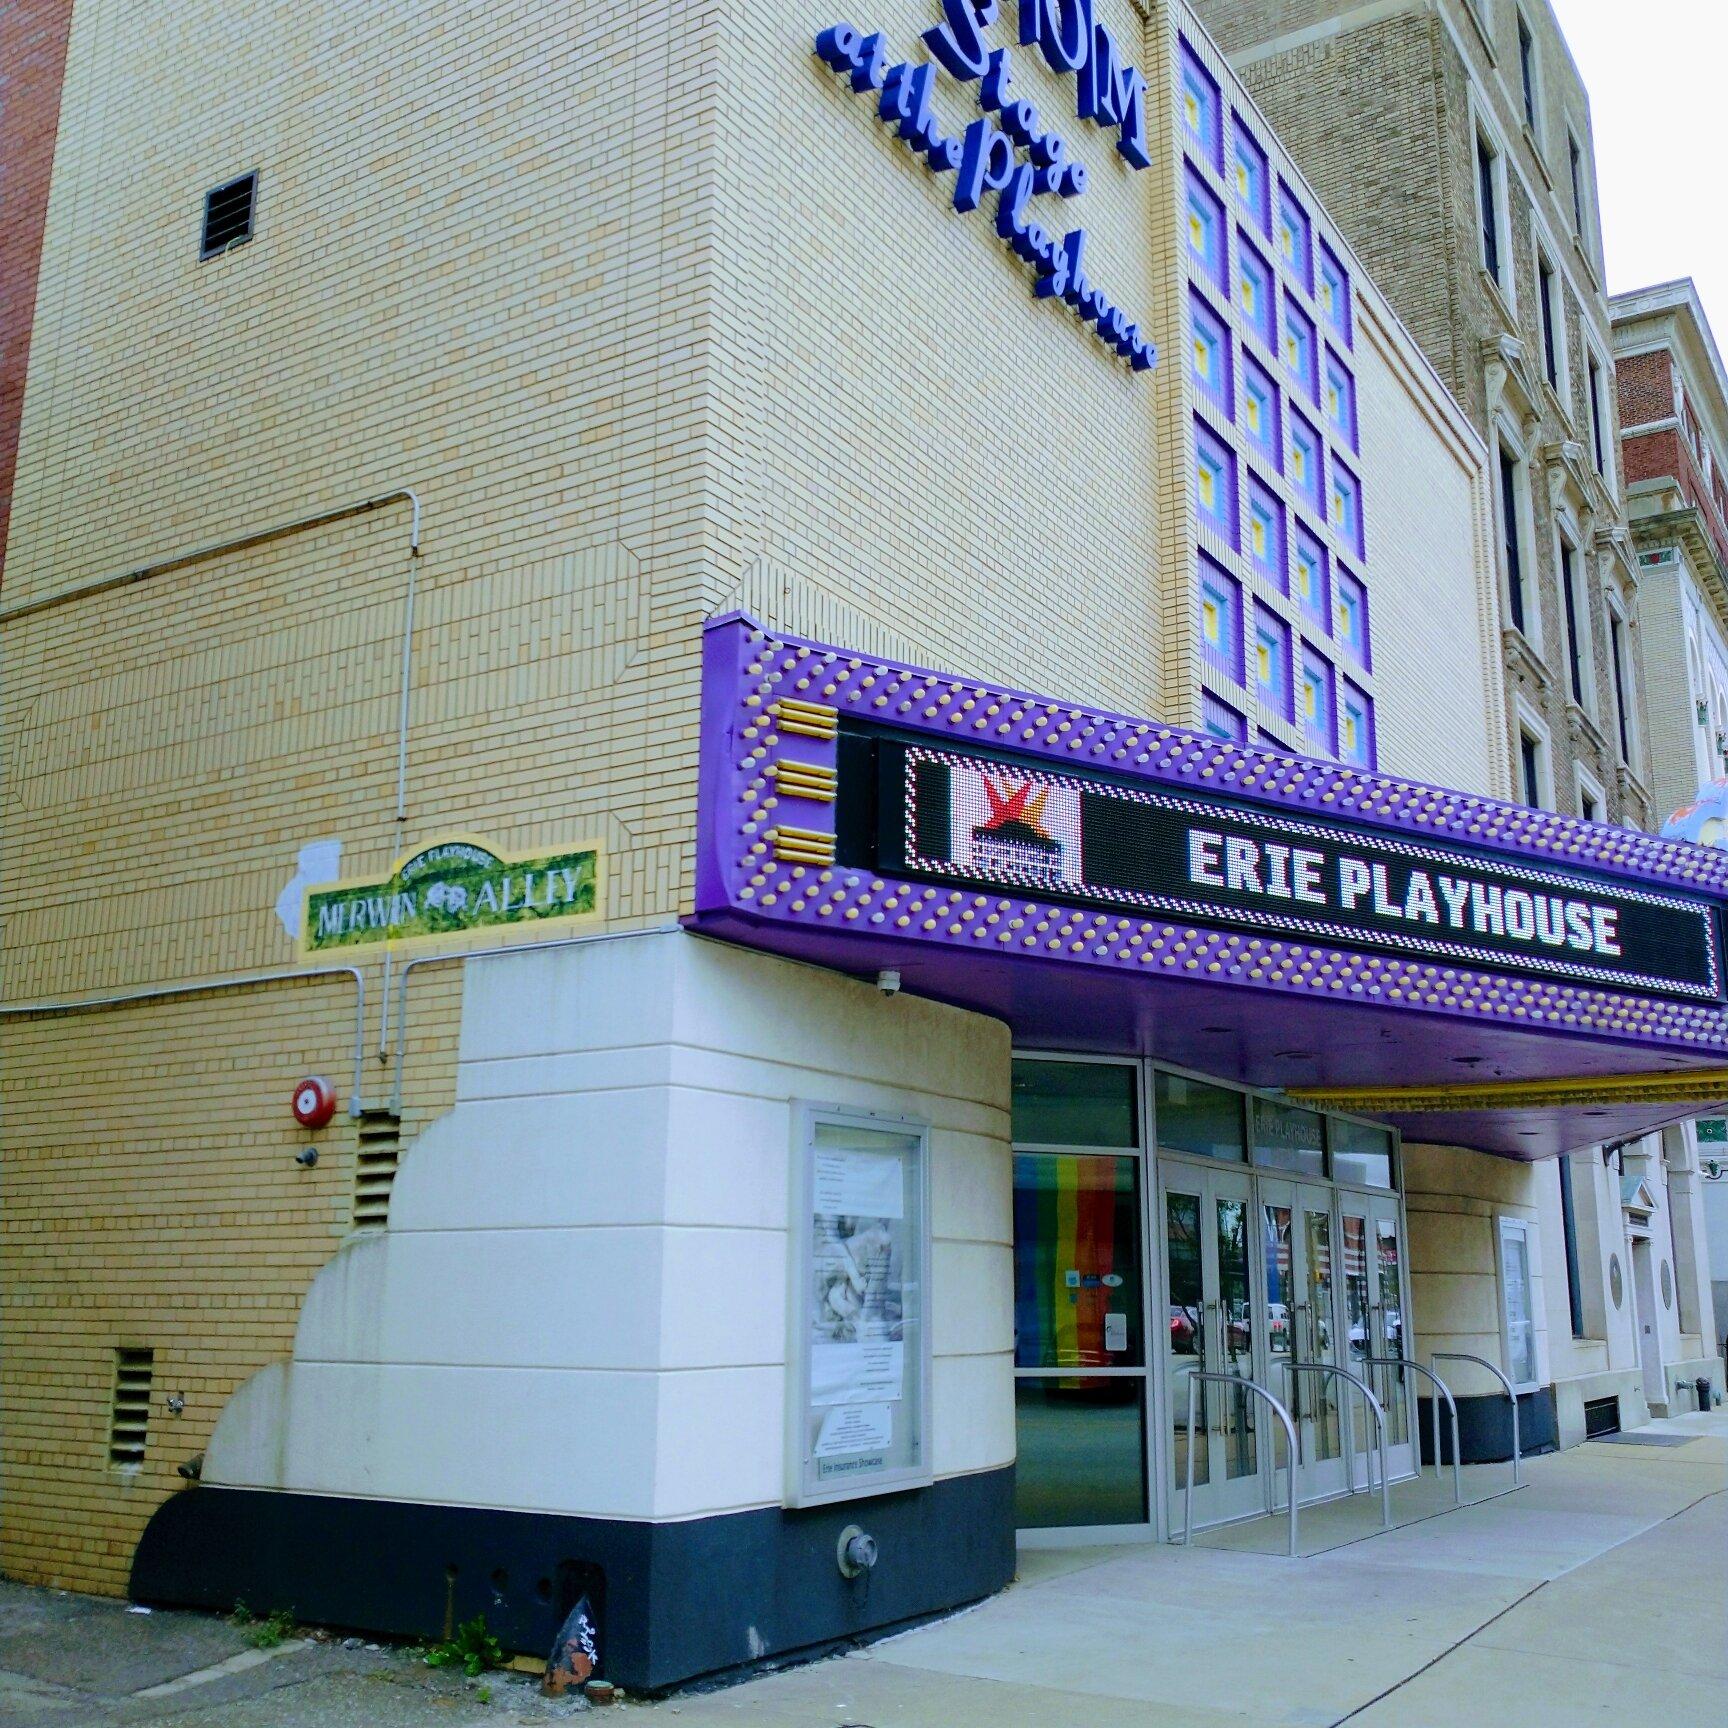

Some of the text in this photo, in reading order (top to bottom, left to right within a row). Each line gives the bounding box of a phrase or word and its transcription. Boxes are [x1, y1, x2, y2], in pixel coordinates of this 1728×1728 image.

[815, 22, 887, 94] at
[876, 62, 966, 173] the
[472, 866, 582, 916] ALLEY
[1188, 828, 1622, 956] ERIE PLAYHOUSE
